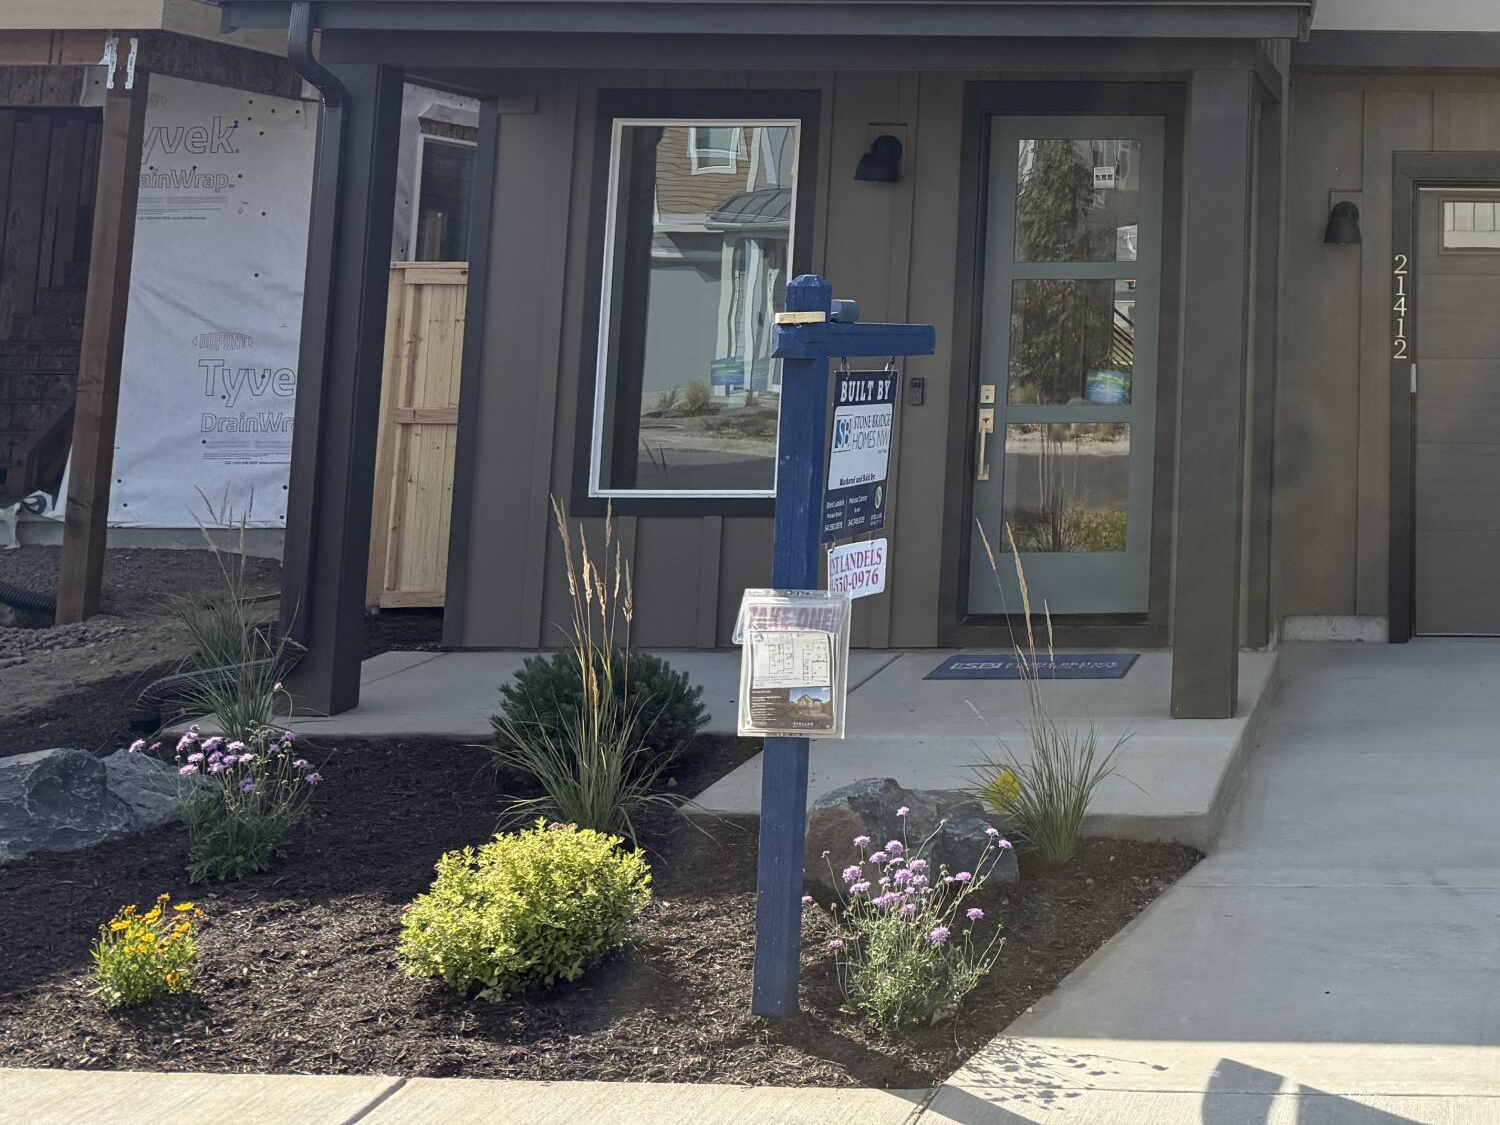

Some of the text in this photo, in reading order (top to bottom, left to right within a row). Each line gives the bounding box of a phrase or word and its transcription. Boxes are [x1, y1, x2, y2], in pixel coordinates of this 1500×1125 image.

[1393, 254, 1408, 359] 21412
[840, 379, 891, 402] BUILT BY
[200, 412, 294, 433] DrainWr
[853, 413, 891, 429] STONE BRIDGE
[851, 431, 876, 450] HOMES
[840, 548, 882, 573] LANDELS
